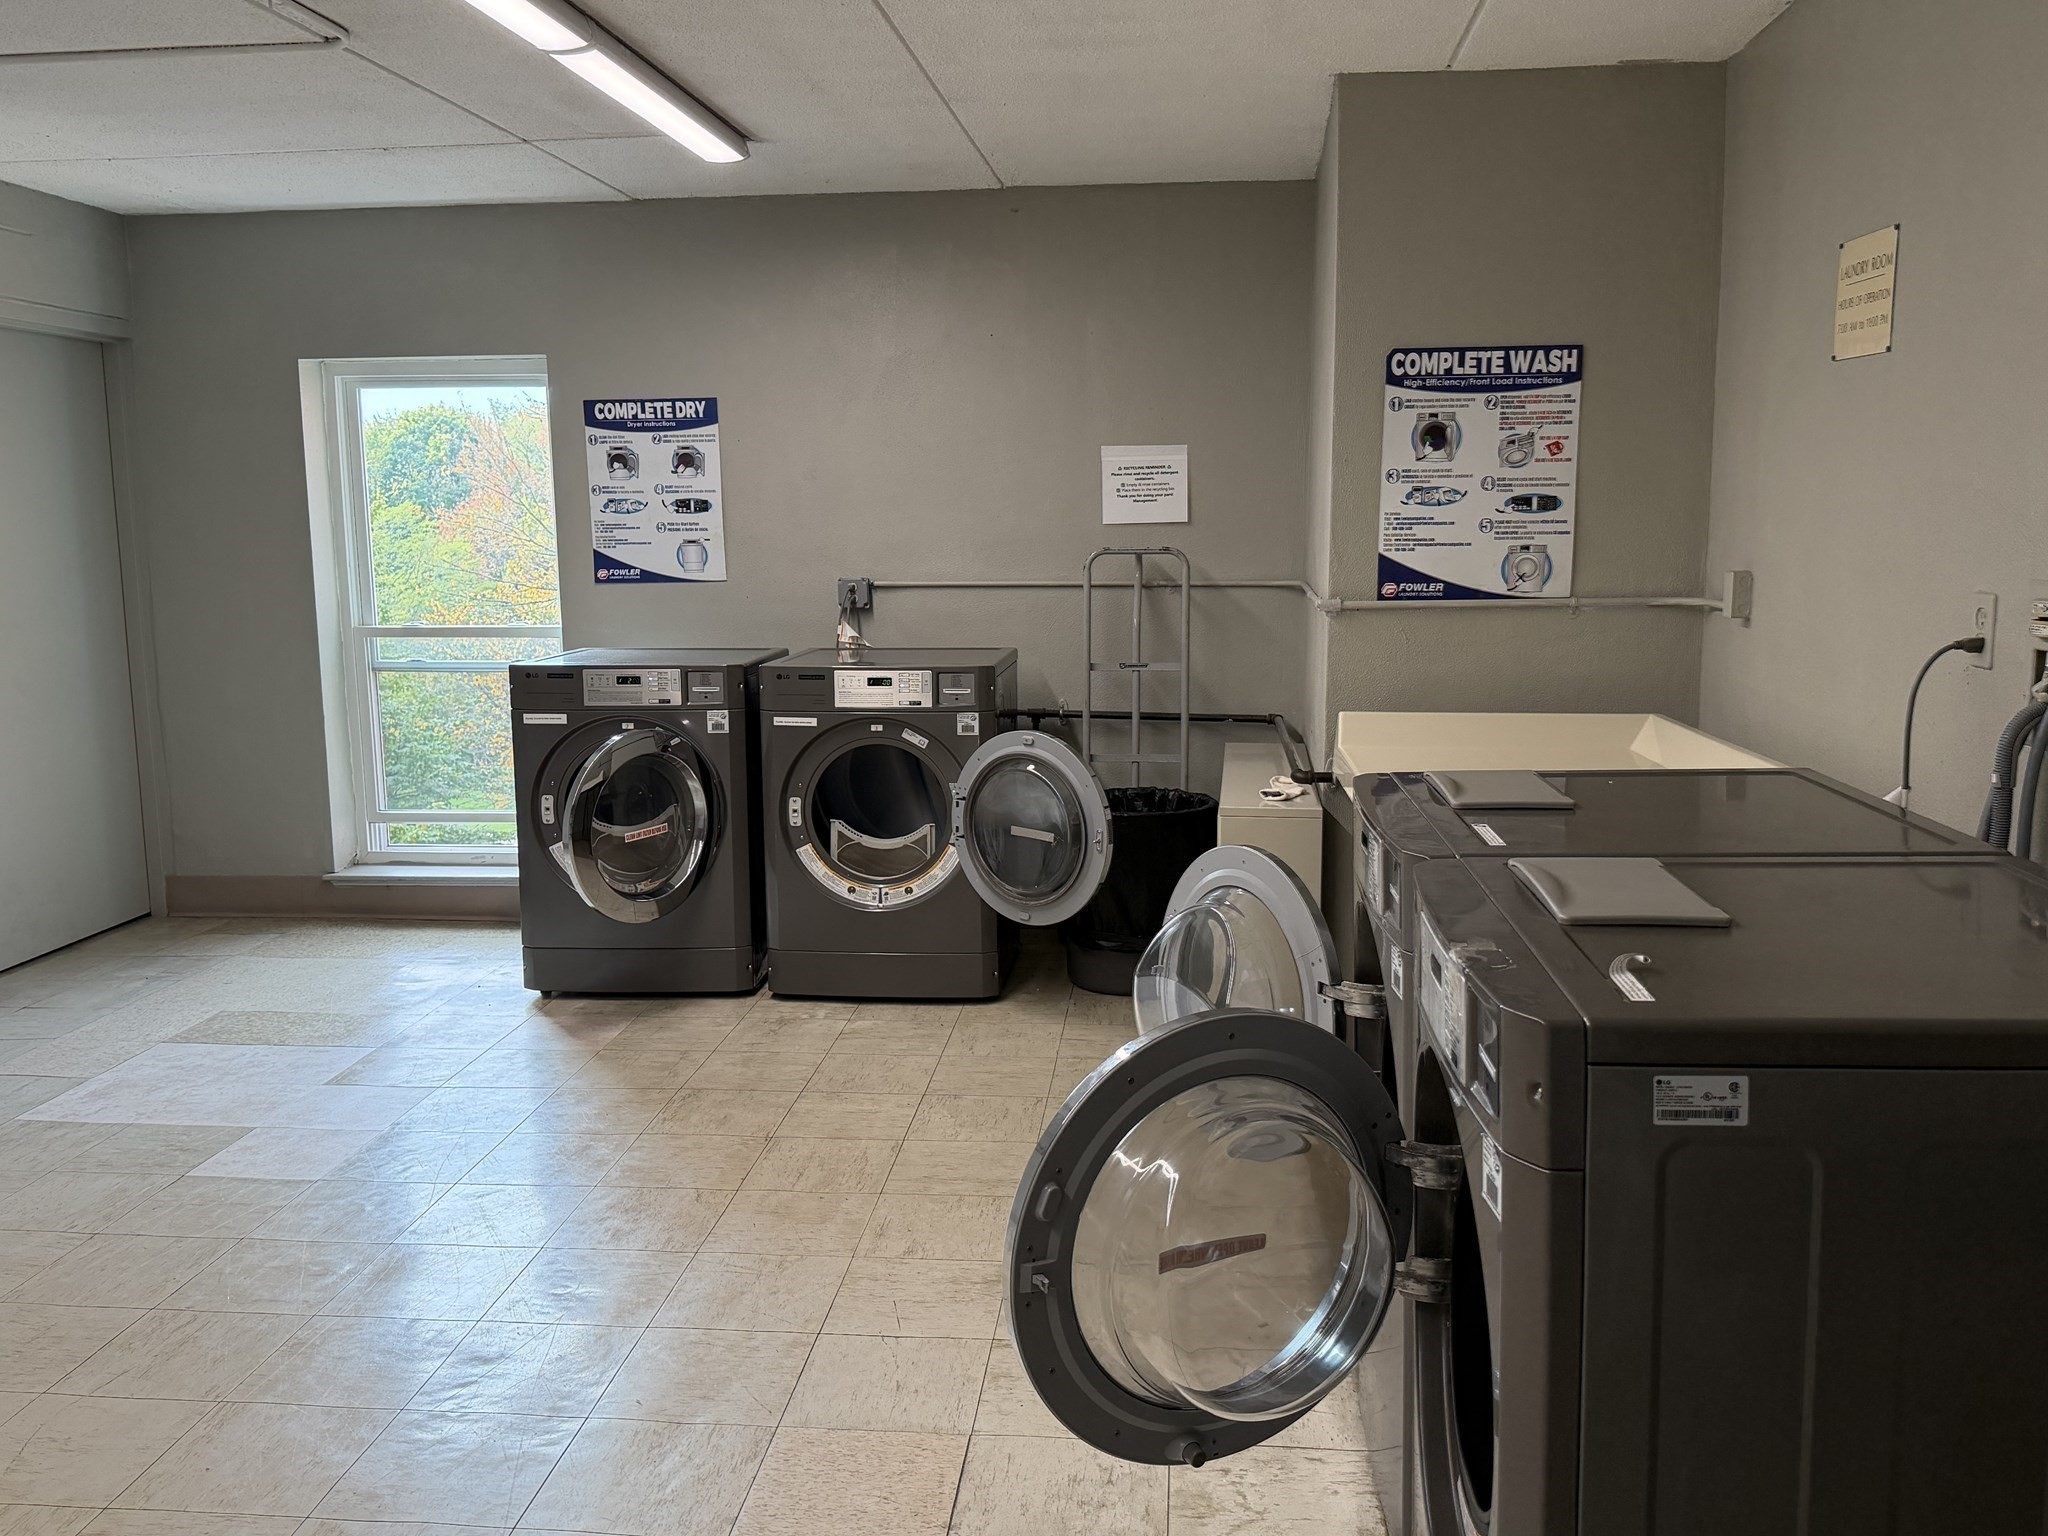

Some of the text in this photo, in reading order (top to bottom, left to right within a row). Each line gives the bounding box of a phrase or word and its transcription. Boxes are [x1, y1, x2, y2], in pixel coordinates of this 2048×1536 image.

[1840, 252, 1894, 281] LAUNDRY ROOM
[1391, 349, 1578, 376] COMPLETE WASH
[1515, 376, 1563, 384] Instructions
[594, 401, 706, 420] COMPLETE DRY
[1399, 583, 1444, 592] FOWLER
